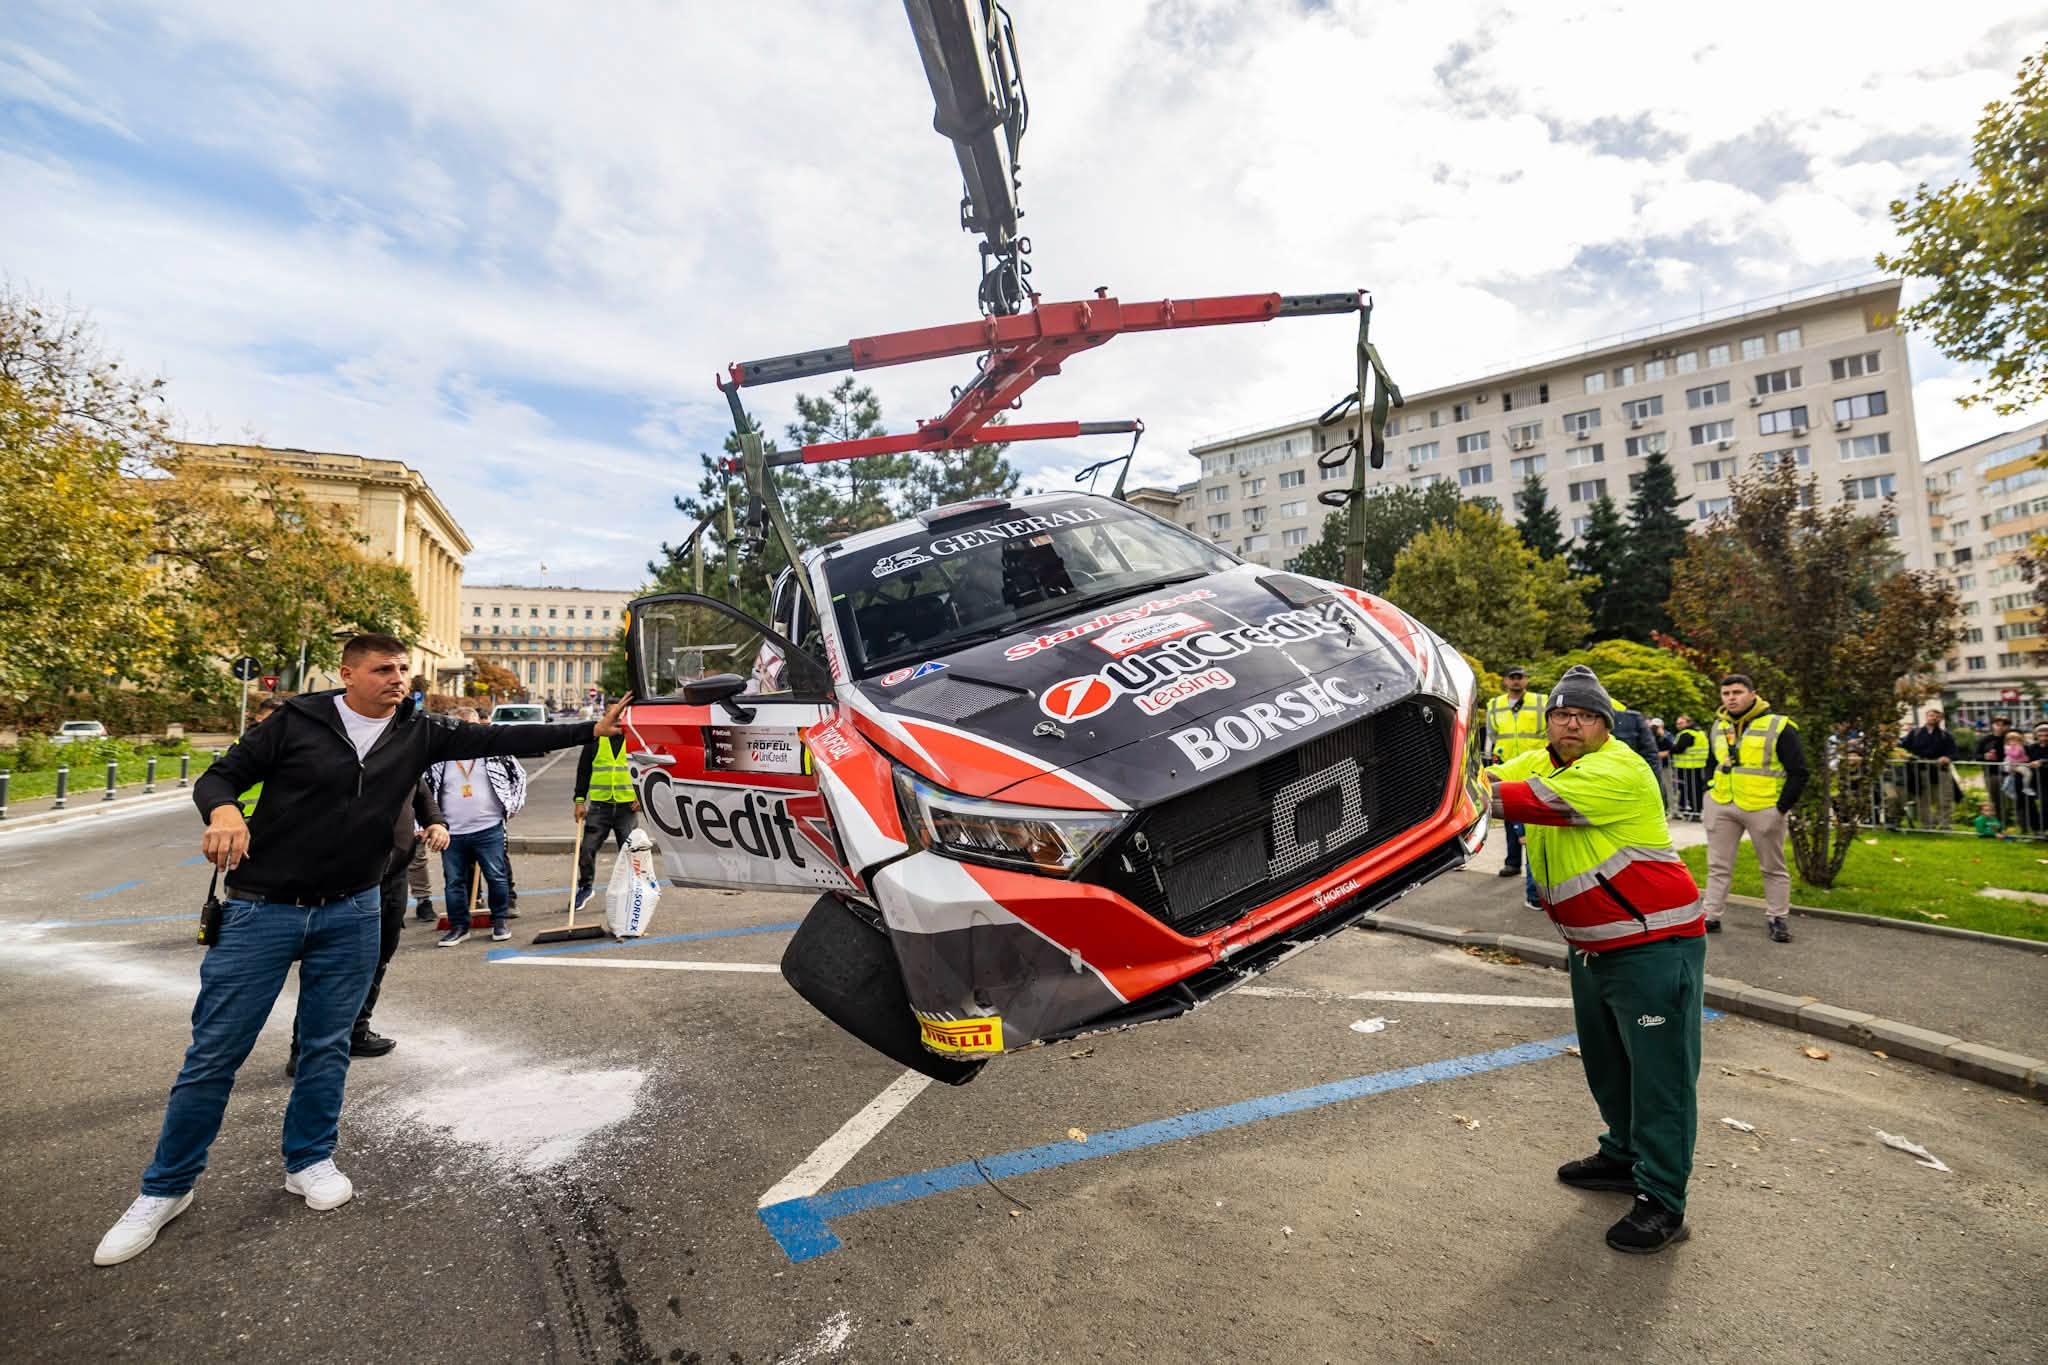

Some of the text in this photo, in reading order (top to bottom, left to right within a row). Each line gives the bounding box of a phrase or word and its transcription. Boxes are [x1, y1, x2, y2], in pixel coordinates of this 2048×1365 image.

[930, 508, 1107, 556] GENERALI
[1005, 589, 1216, 661] Stanleybet
[1107, 611, 1339, 691] UniCredit
[1140, 671, 1229, 711] Leasing
[1168, 677, 1369, 772] BORSEC
[747, 742, 793, 751] TROFEUL
[760, 751, 788, 763] UniCredit
[1322, 879, 1361, 904] HOFIGAL
[922, 1021, 992, 1048] PIRELLI
